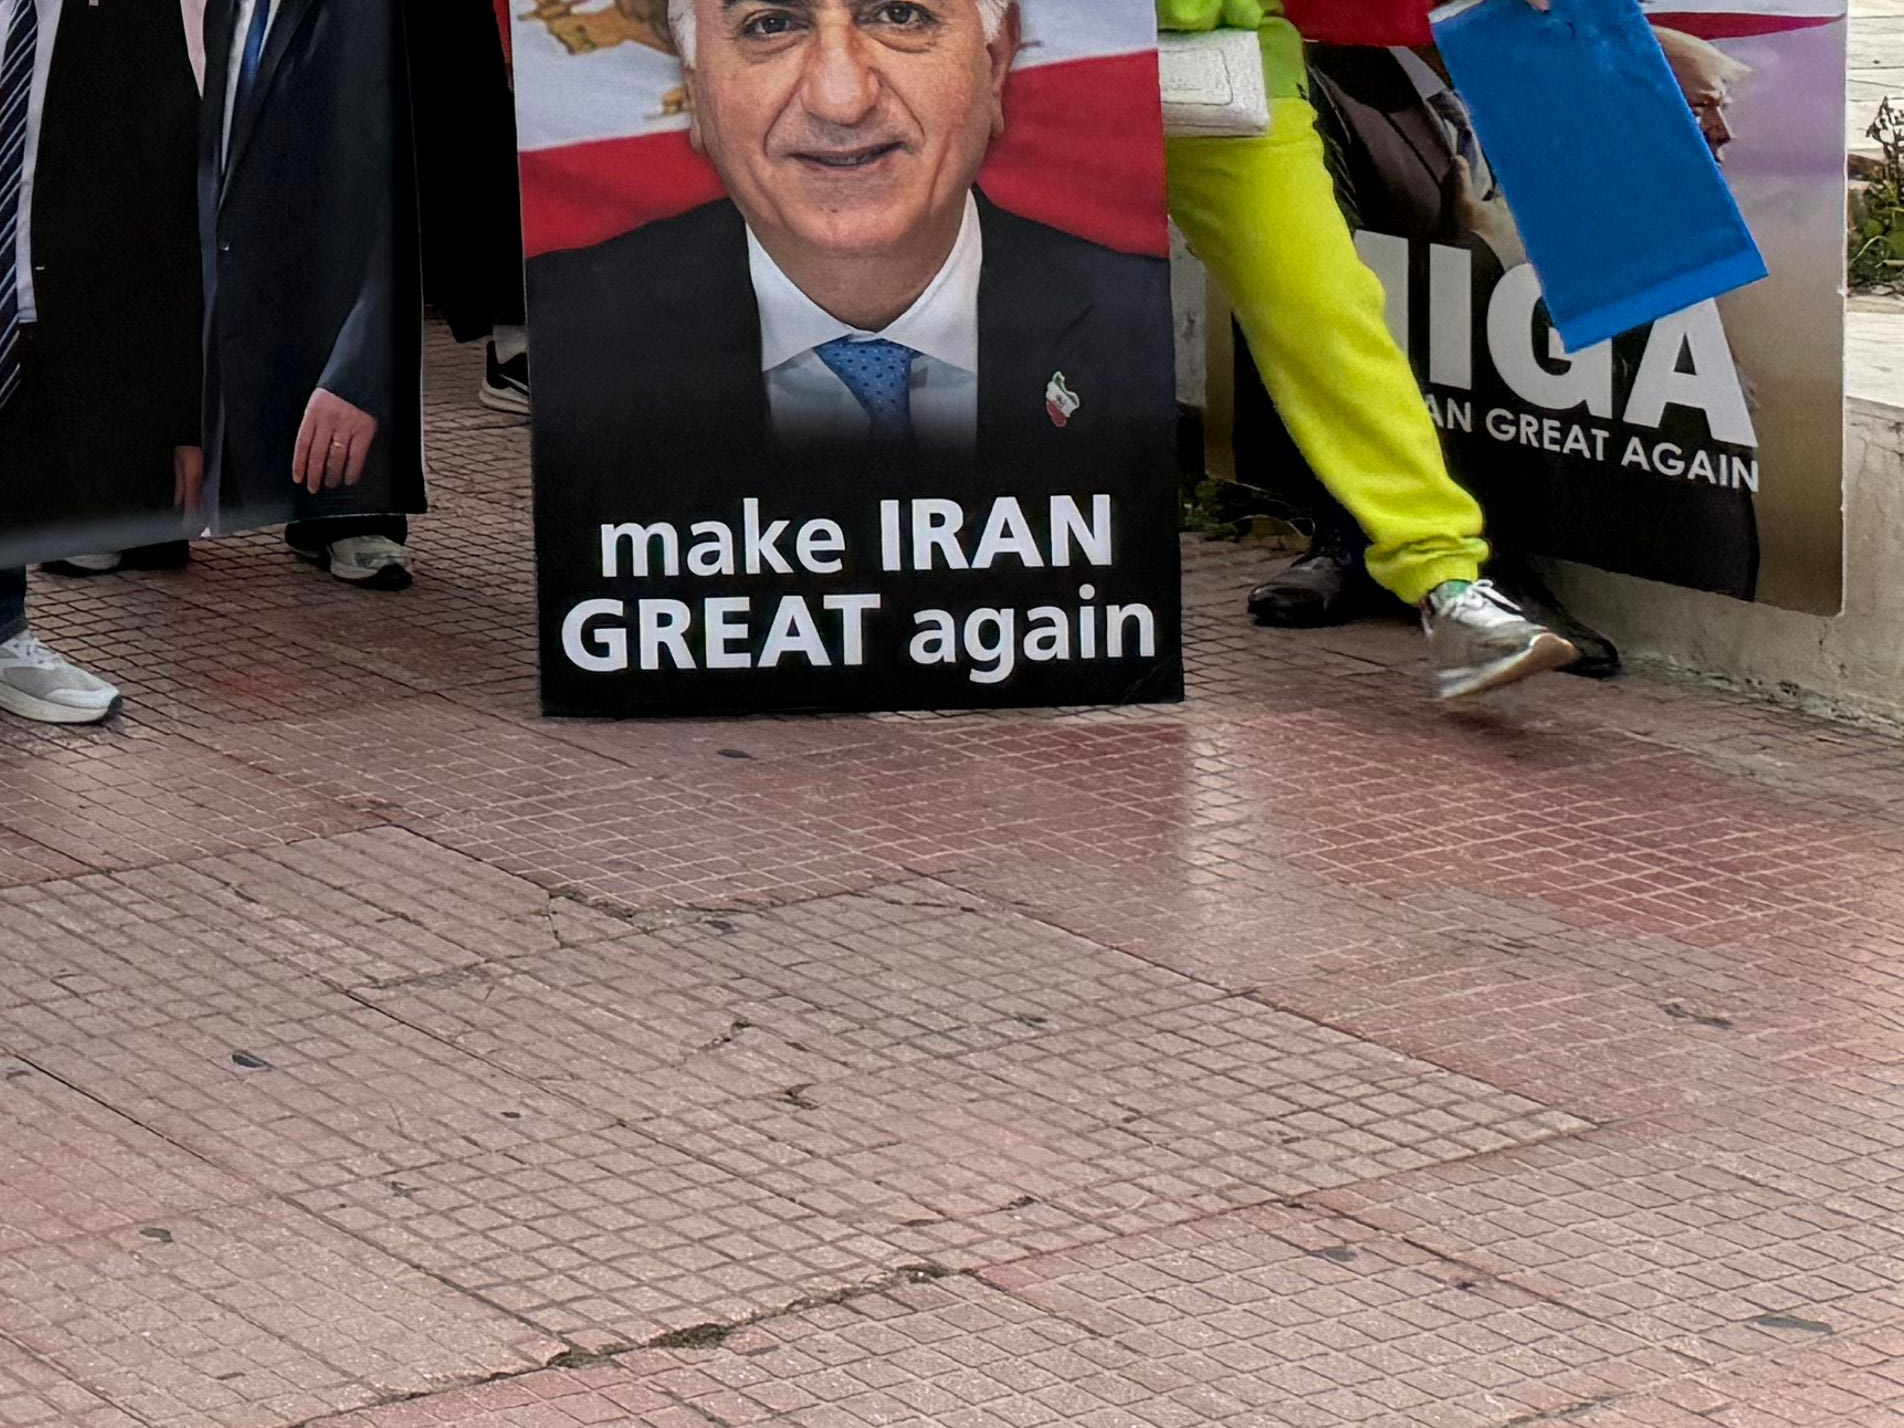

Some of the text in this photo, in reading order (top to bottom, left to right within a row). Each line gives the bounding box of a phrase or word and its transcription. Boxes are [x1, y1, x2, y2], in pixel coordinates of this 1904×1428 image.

[1425, 393, 1758, 493] AN GREAT AGAIN
[600, 494, 1112, 578] make IRAN
[561, 584, 1156, 685] GREAT again
